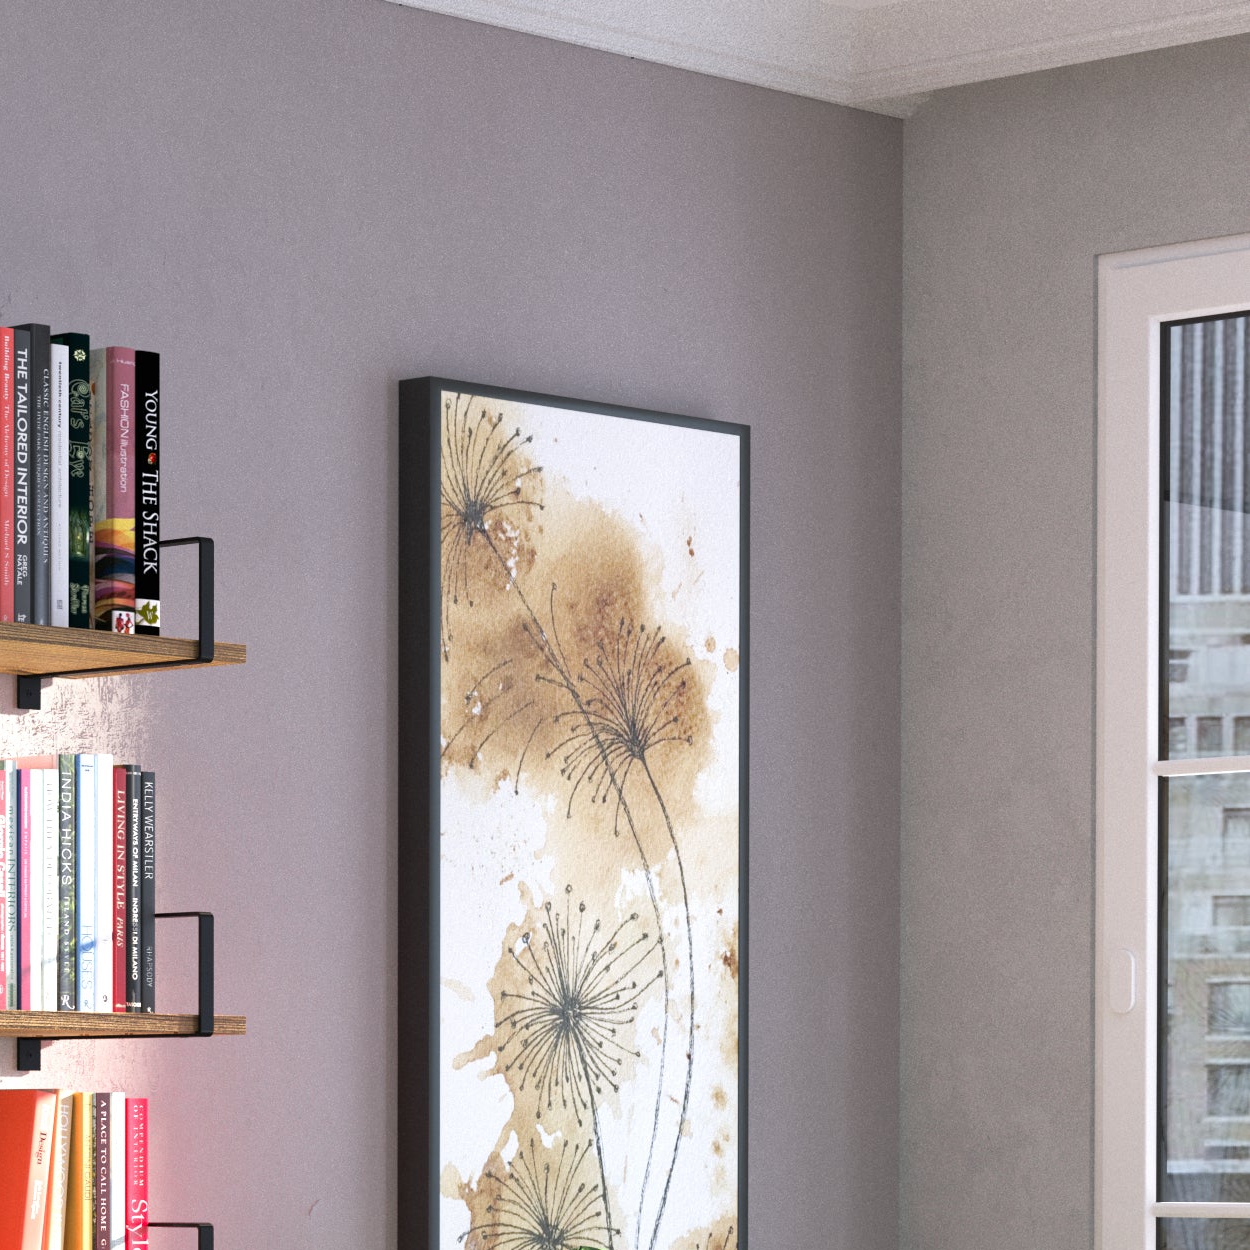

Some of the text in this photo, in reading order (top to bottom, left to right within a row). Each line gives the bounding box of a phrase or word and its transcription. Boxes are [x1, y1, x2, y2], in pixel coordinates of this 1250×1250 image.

[16, 348, 28, 545] THE TAILORED INTERIOR
[69, 440, 91, 478] Eye
[119, 383, 130, 493] FASHION illustration
[42, 454, 50, 489] DESIGN
[142, 390, 159, 575] YOUNG THE SHACK
[42, 515, 50, 564] ANTIQUES
[61, 771, 72, 825] INDIA
[144, 782, 154, 812] KELLY
[61, 828, 72, 886] HICKS
[116, 789, 126, 948] LIVING IN STYLE PARIS
[132, 847, 139, 858] OF
[144, 815, 154, 880] WEARSTLER
[7, 858, 17, 932] INTERIORS
[132, 936, 139, 945] DI
[100, 1100, 107, 1108] A
[133, 1104, 138, 1119] OF
[35, 1132, 47, 1165] Design
[100, 1147, 107, 1164] TO
